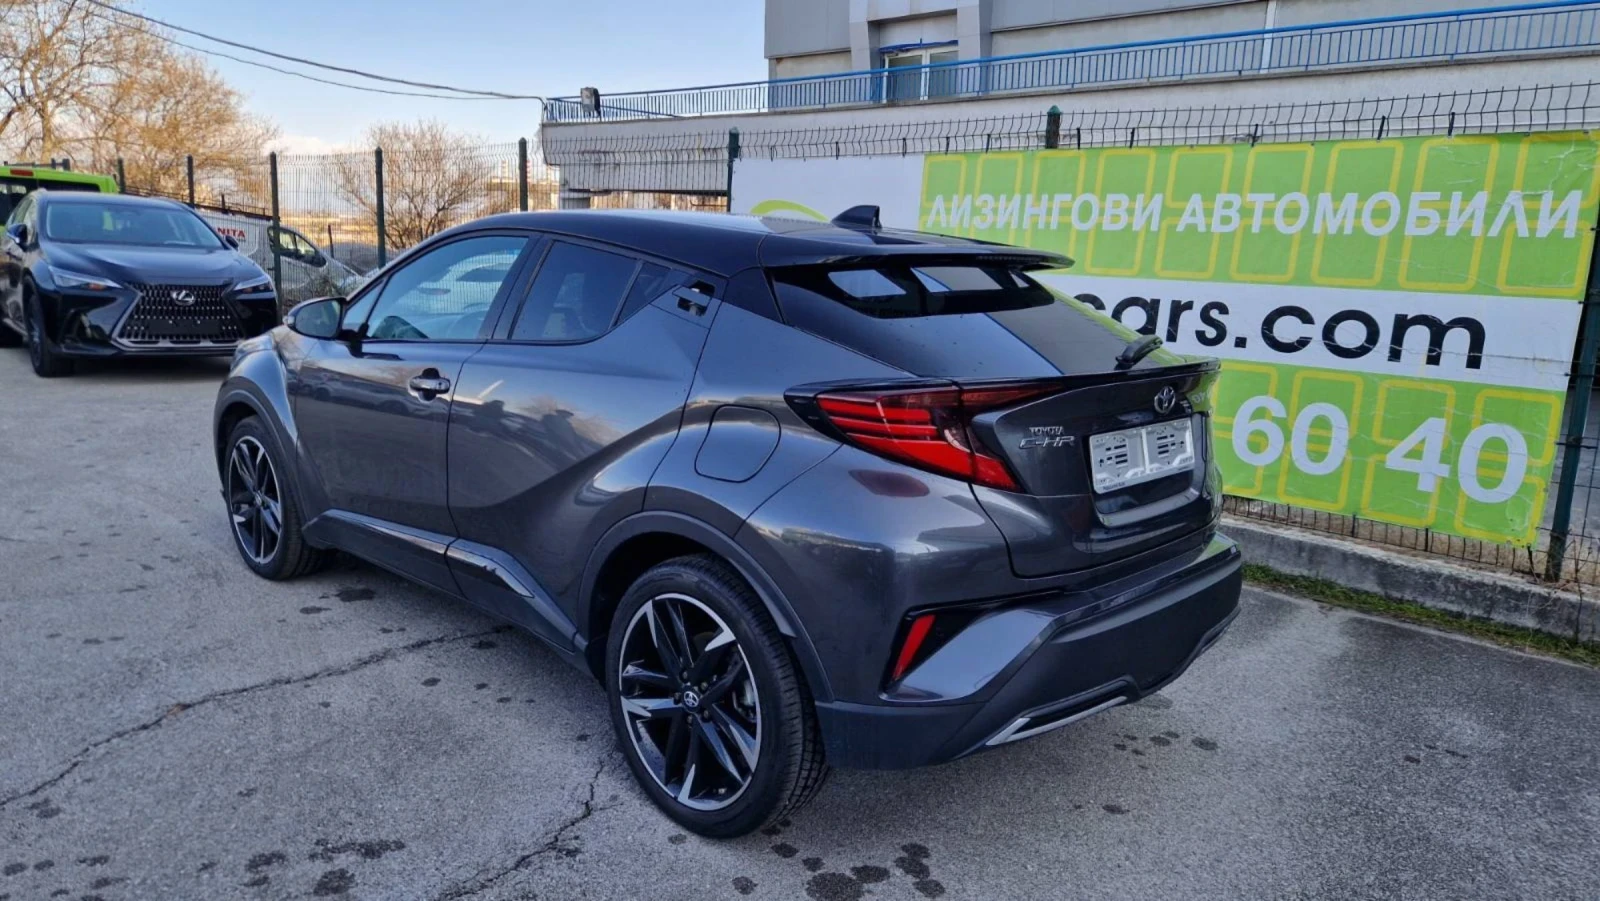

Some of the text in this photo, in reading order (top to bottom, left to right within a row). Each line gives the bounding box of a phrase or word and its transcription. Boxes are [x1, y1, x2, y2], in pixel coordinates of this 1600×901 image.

[926, 190, 1583, 239] ЛИЗИНГОВИ АВТОМОБИЛИ
[1019, 435, 1075, 449] C-HR
[1029, 426, 1064, 436] TOYOTA
[1232, 395, 1529, 504] 60 40
